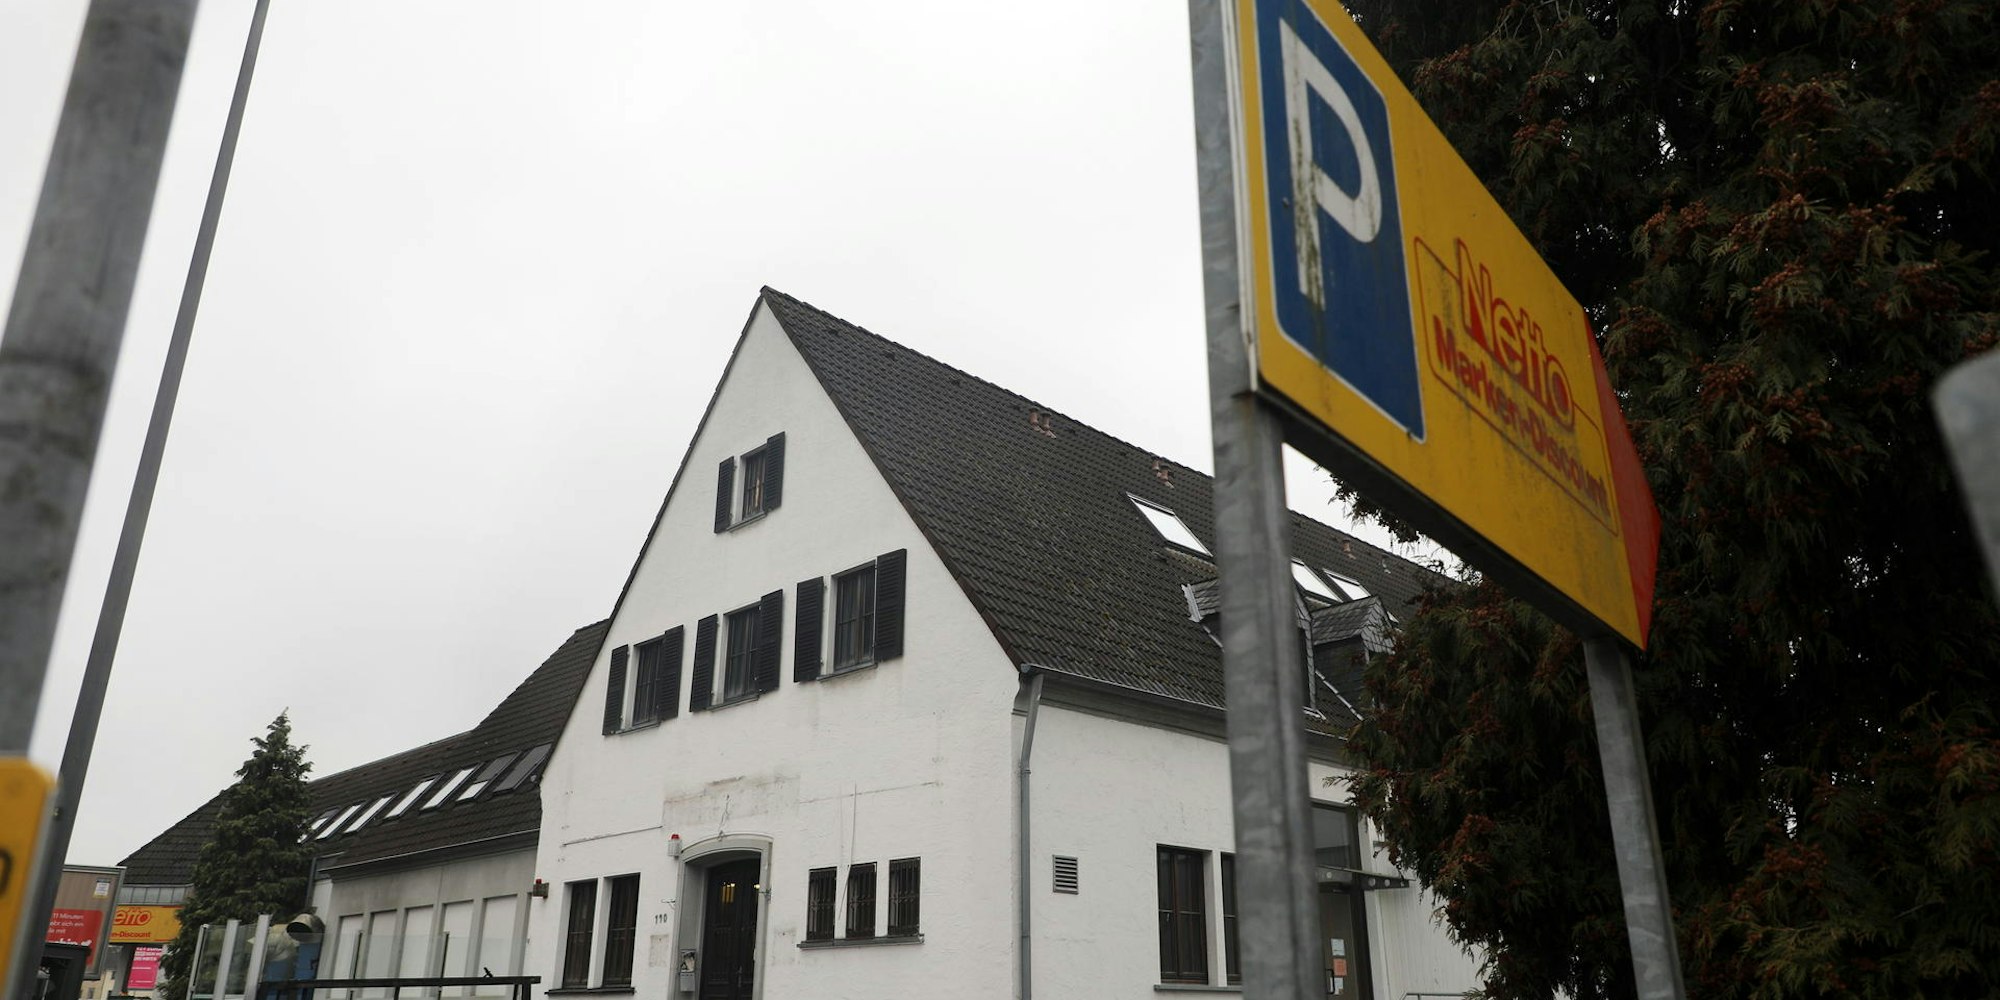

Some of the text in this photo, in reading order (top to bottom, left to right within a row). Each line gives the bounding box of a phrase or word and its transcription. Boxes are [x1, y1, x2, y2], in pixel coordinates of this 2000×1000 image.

[1279, 17, 1383, 312] P
[1454, 237, 1576, 433] Netto
[1433, 314, 1612, 520] Marken-Discount
[111, 930, 151, 938] n-Discount
[112, 906, 152, 926] etto
[655, 913, 668, 924] 110
